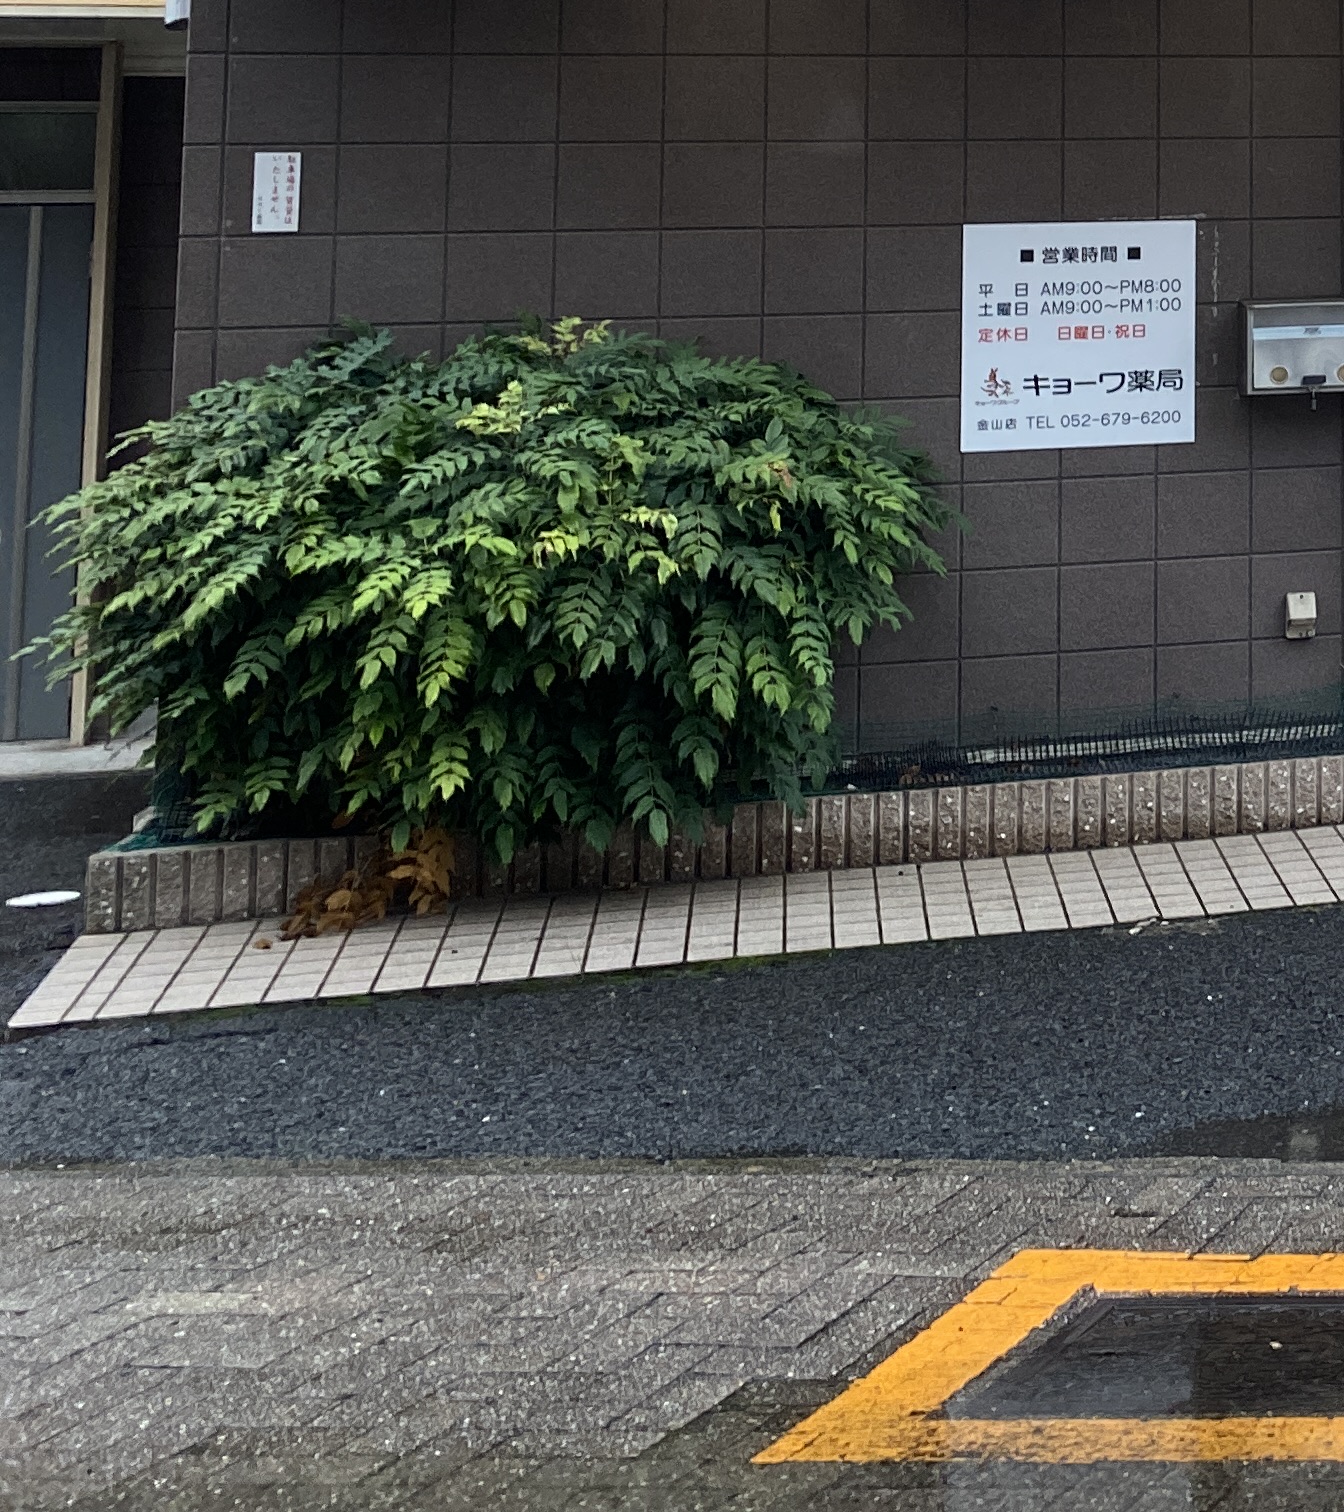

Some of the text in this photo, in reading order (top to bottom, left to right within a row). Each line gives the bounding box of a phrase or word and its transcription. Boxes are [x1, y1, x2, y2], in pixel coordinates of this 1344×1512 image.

[1042, 246, 1118, 264] 営業時間
[978, 301, 1029, 317] 土曜日
[978, 327, 1029, 343] 定休日
[1022, 369, 1184, 396] キョーワ薬局
[977, 410, 1182, 431] 金山店 TEL 052-679-6200
